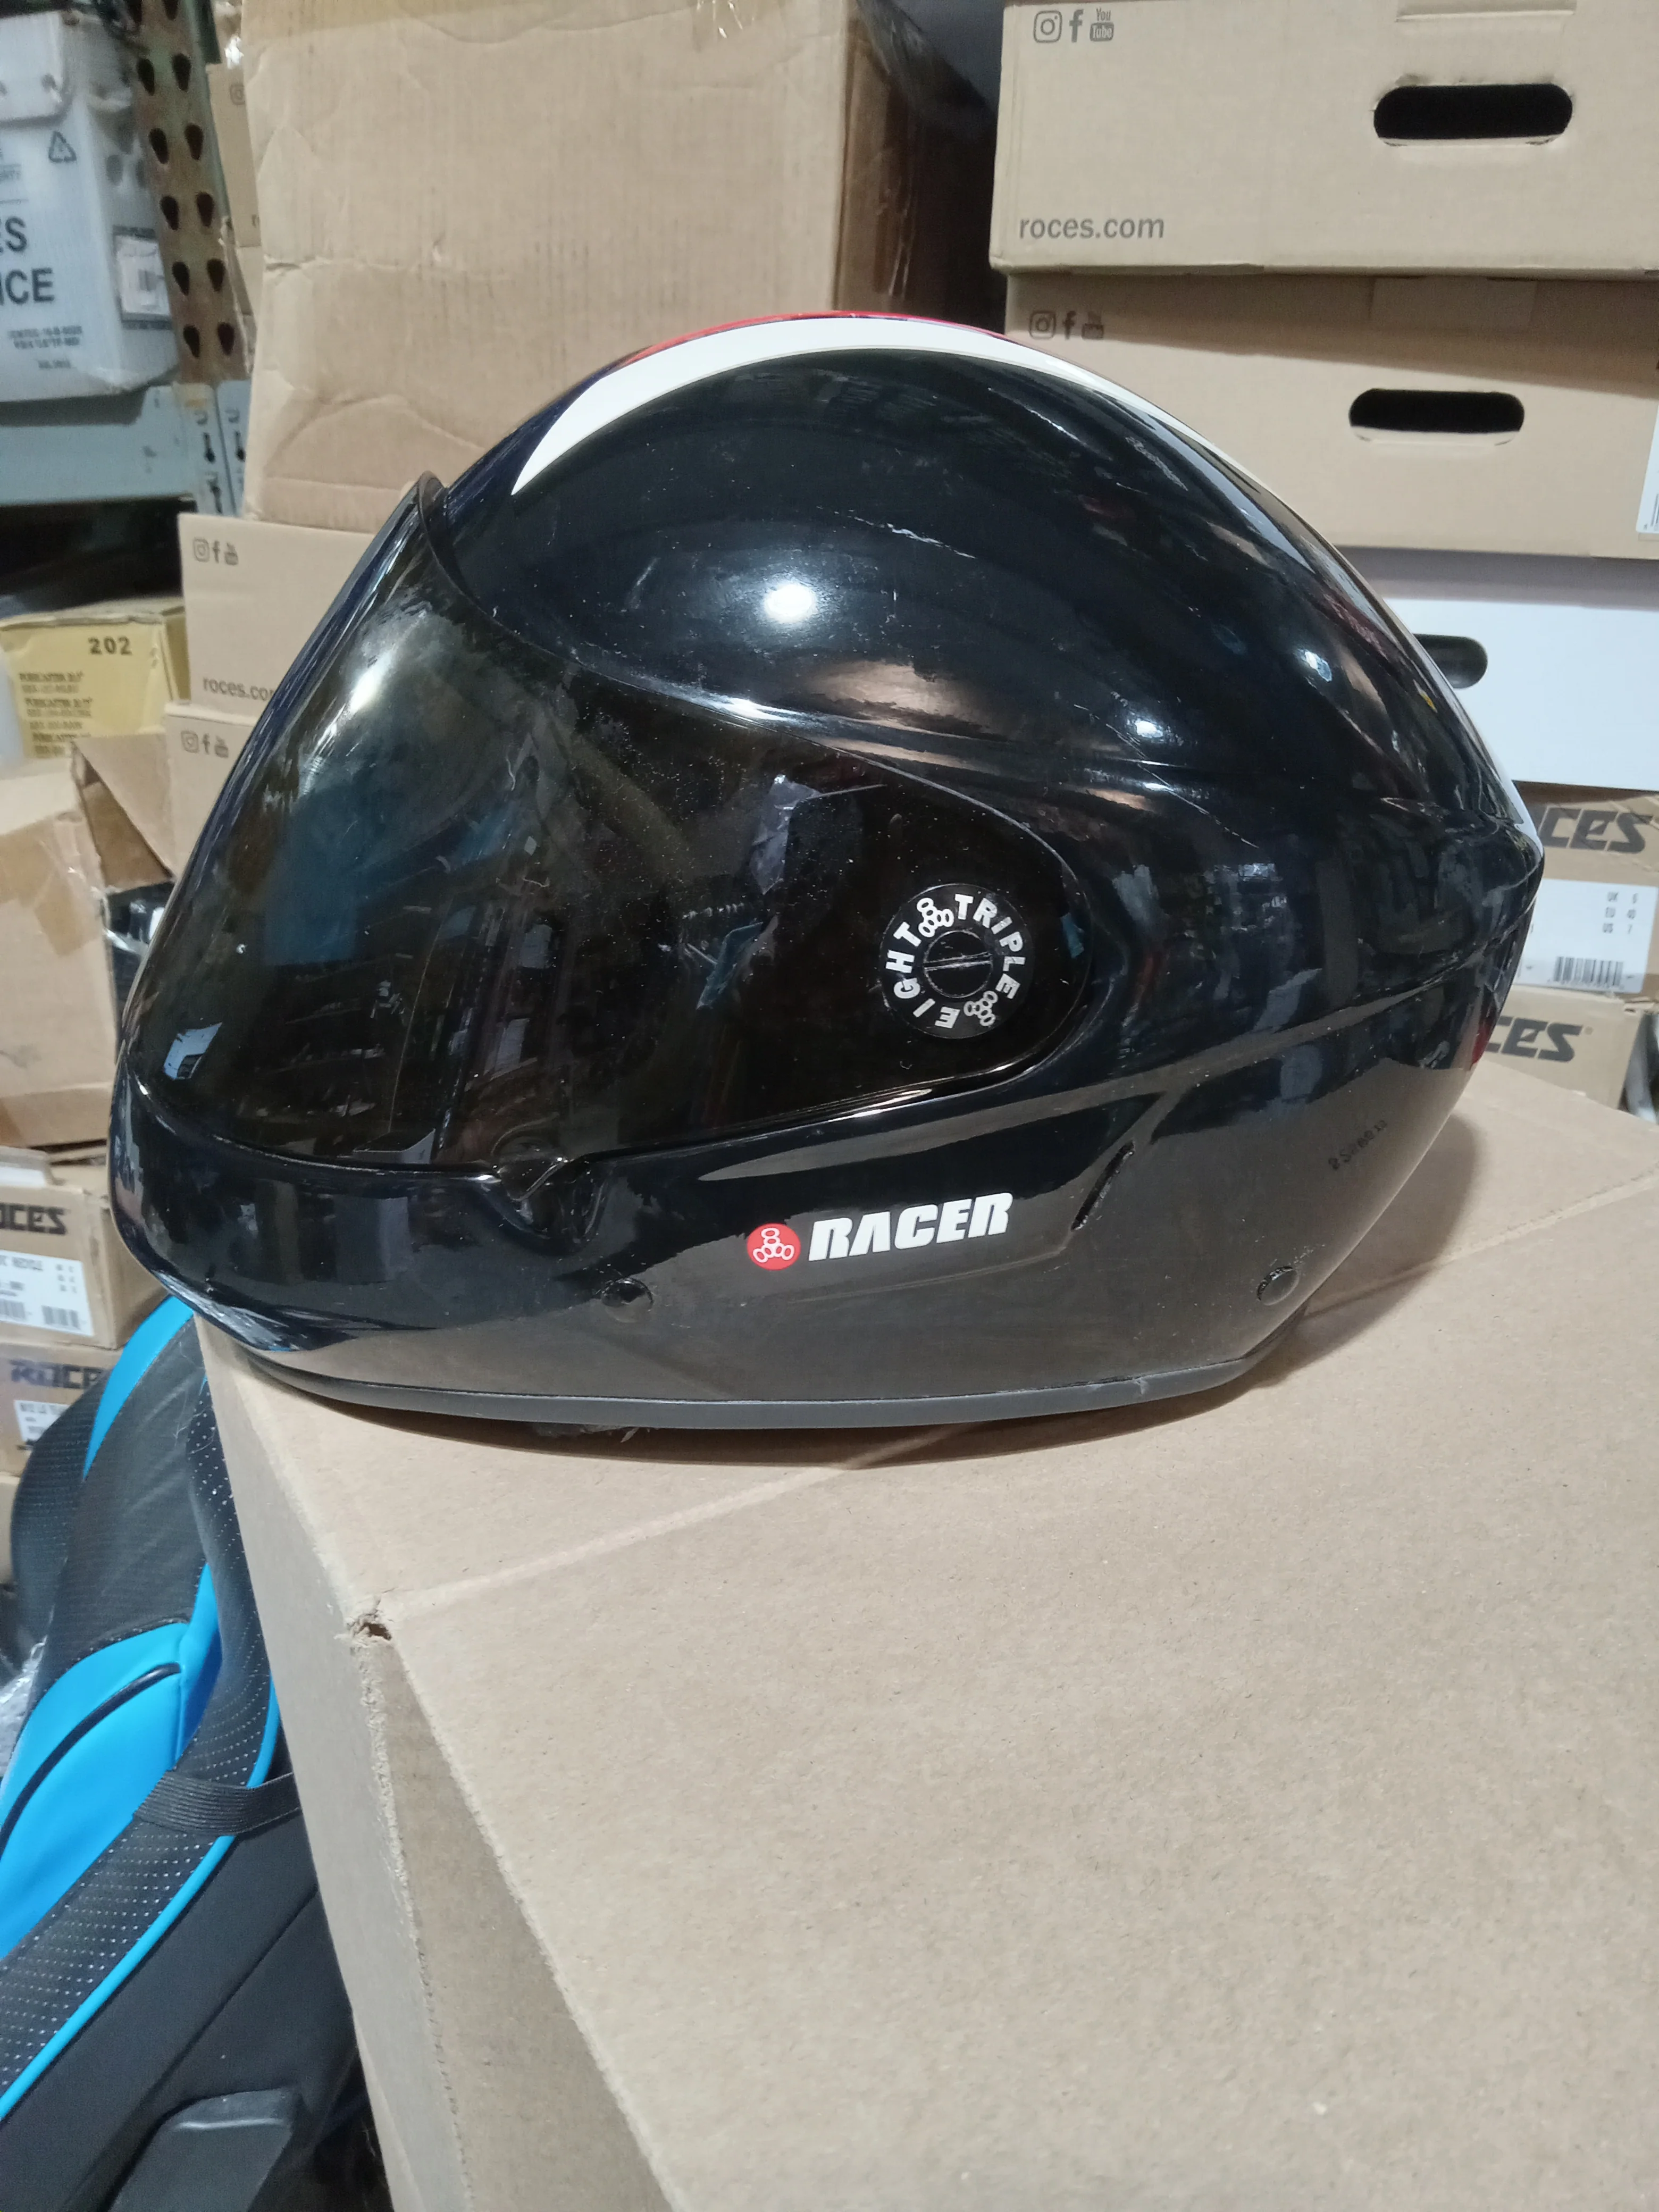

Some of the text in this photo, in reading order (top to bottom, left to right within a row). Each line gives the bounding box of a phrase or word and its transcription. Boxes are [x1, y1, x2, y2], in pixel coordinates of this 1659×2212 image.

[1095, 7, 1111, 21] You
[1091, 24, 1113, 39] Tube
[1019, 218, 1164, 239] roces.com
[88, 635, 133, 656] 202
[954, 893, 1026, 999] TRIPLE
[885, 921, 961, 1029] EIGHT
[808, 1192, 1013, 1262] RACER
